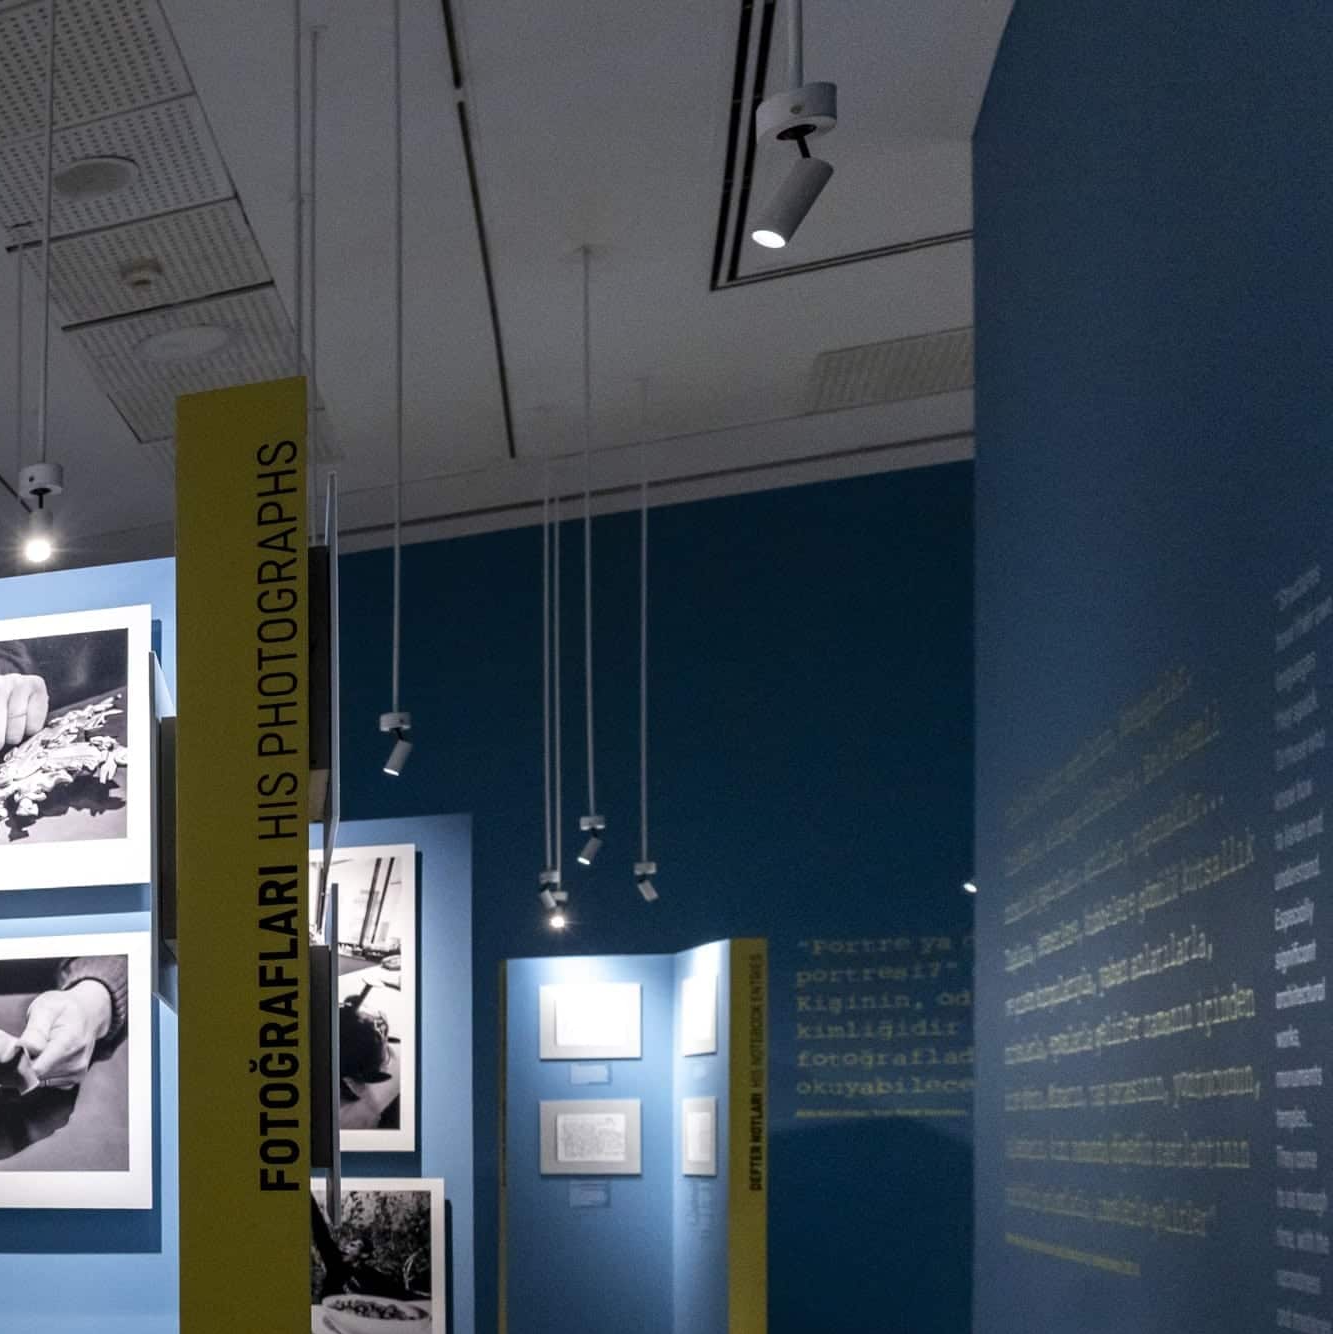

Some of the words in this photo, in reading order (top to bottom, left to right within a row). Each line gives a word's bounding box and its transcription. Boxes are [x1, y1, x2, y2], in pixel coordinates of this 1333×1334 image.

[257, 440, 298, 757] PHOTOGRAPHS
[258, 771, 298, 840] HIS
[249, 865, 300, 1192] FOTOĞRAFLARI
